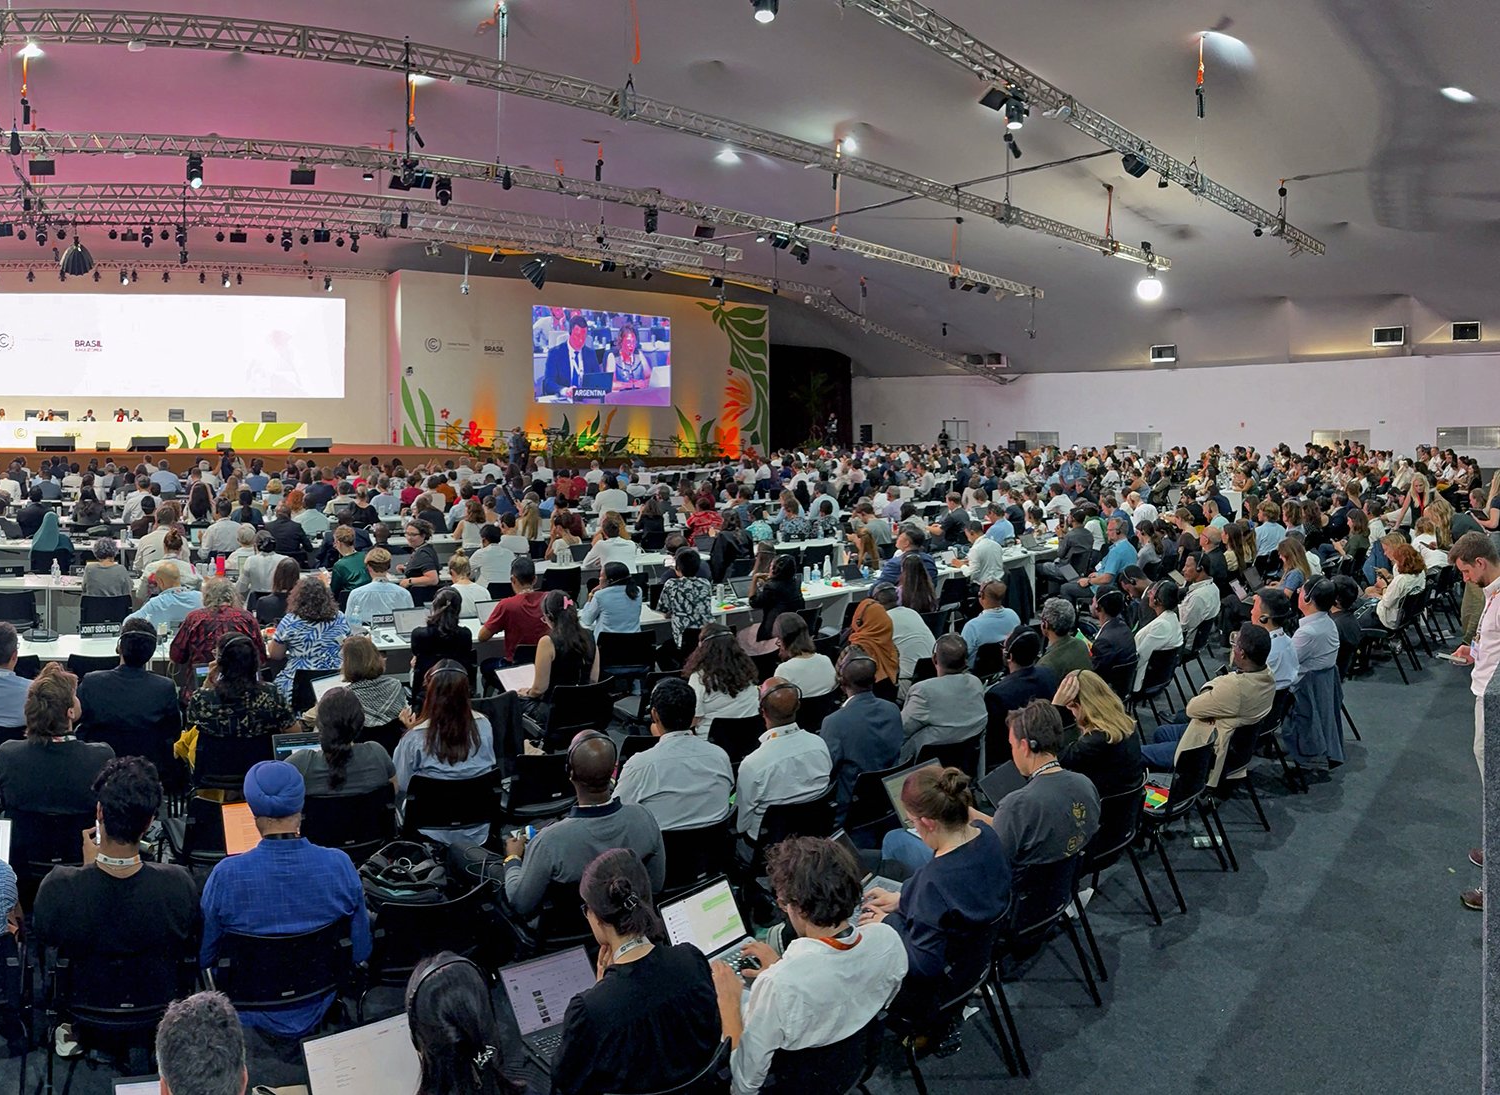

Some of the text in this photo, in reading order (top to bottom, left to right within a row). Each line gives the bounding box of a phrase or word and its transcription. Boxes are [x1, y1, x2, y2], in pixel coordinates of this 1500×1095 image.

[574, 389, 606, 397] ARGENTINA
[81, 625, 95, 633] JOINT
[106, 624, 120, 632] FUND
